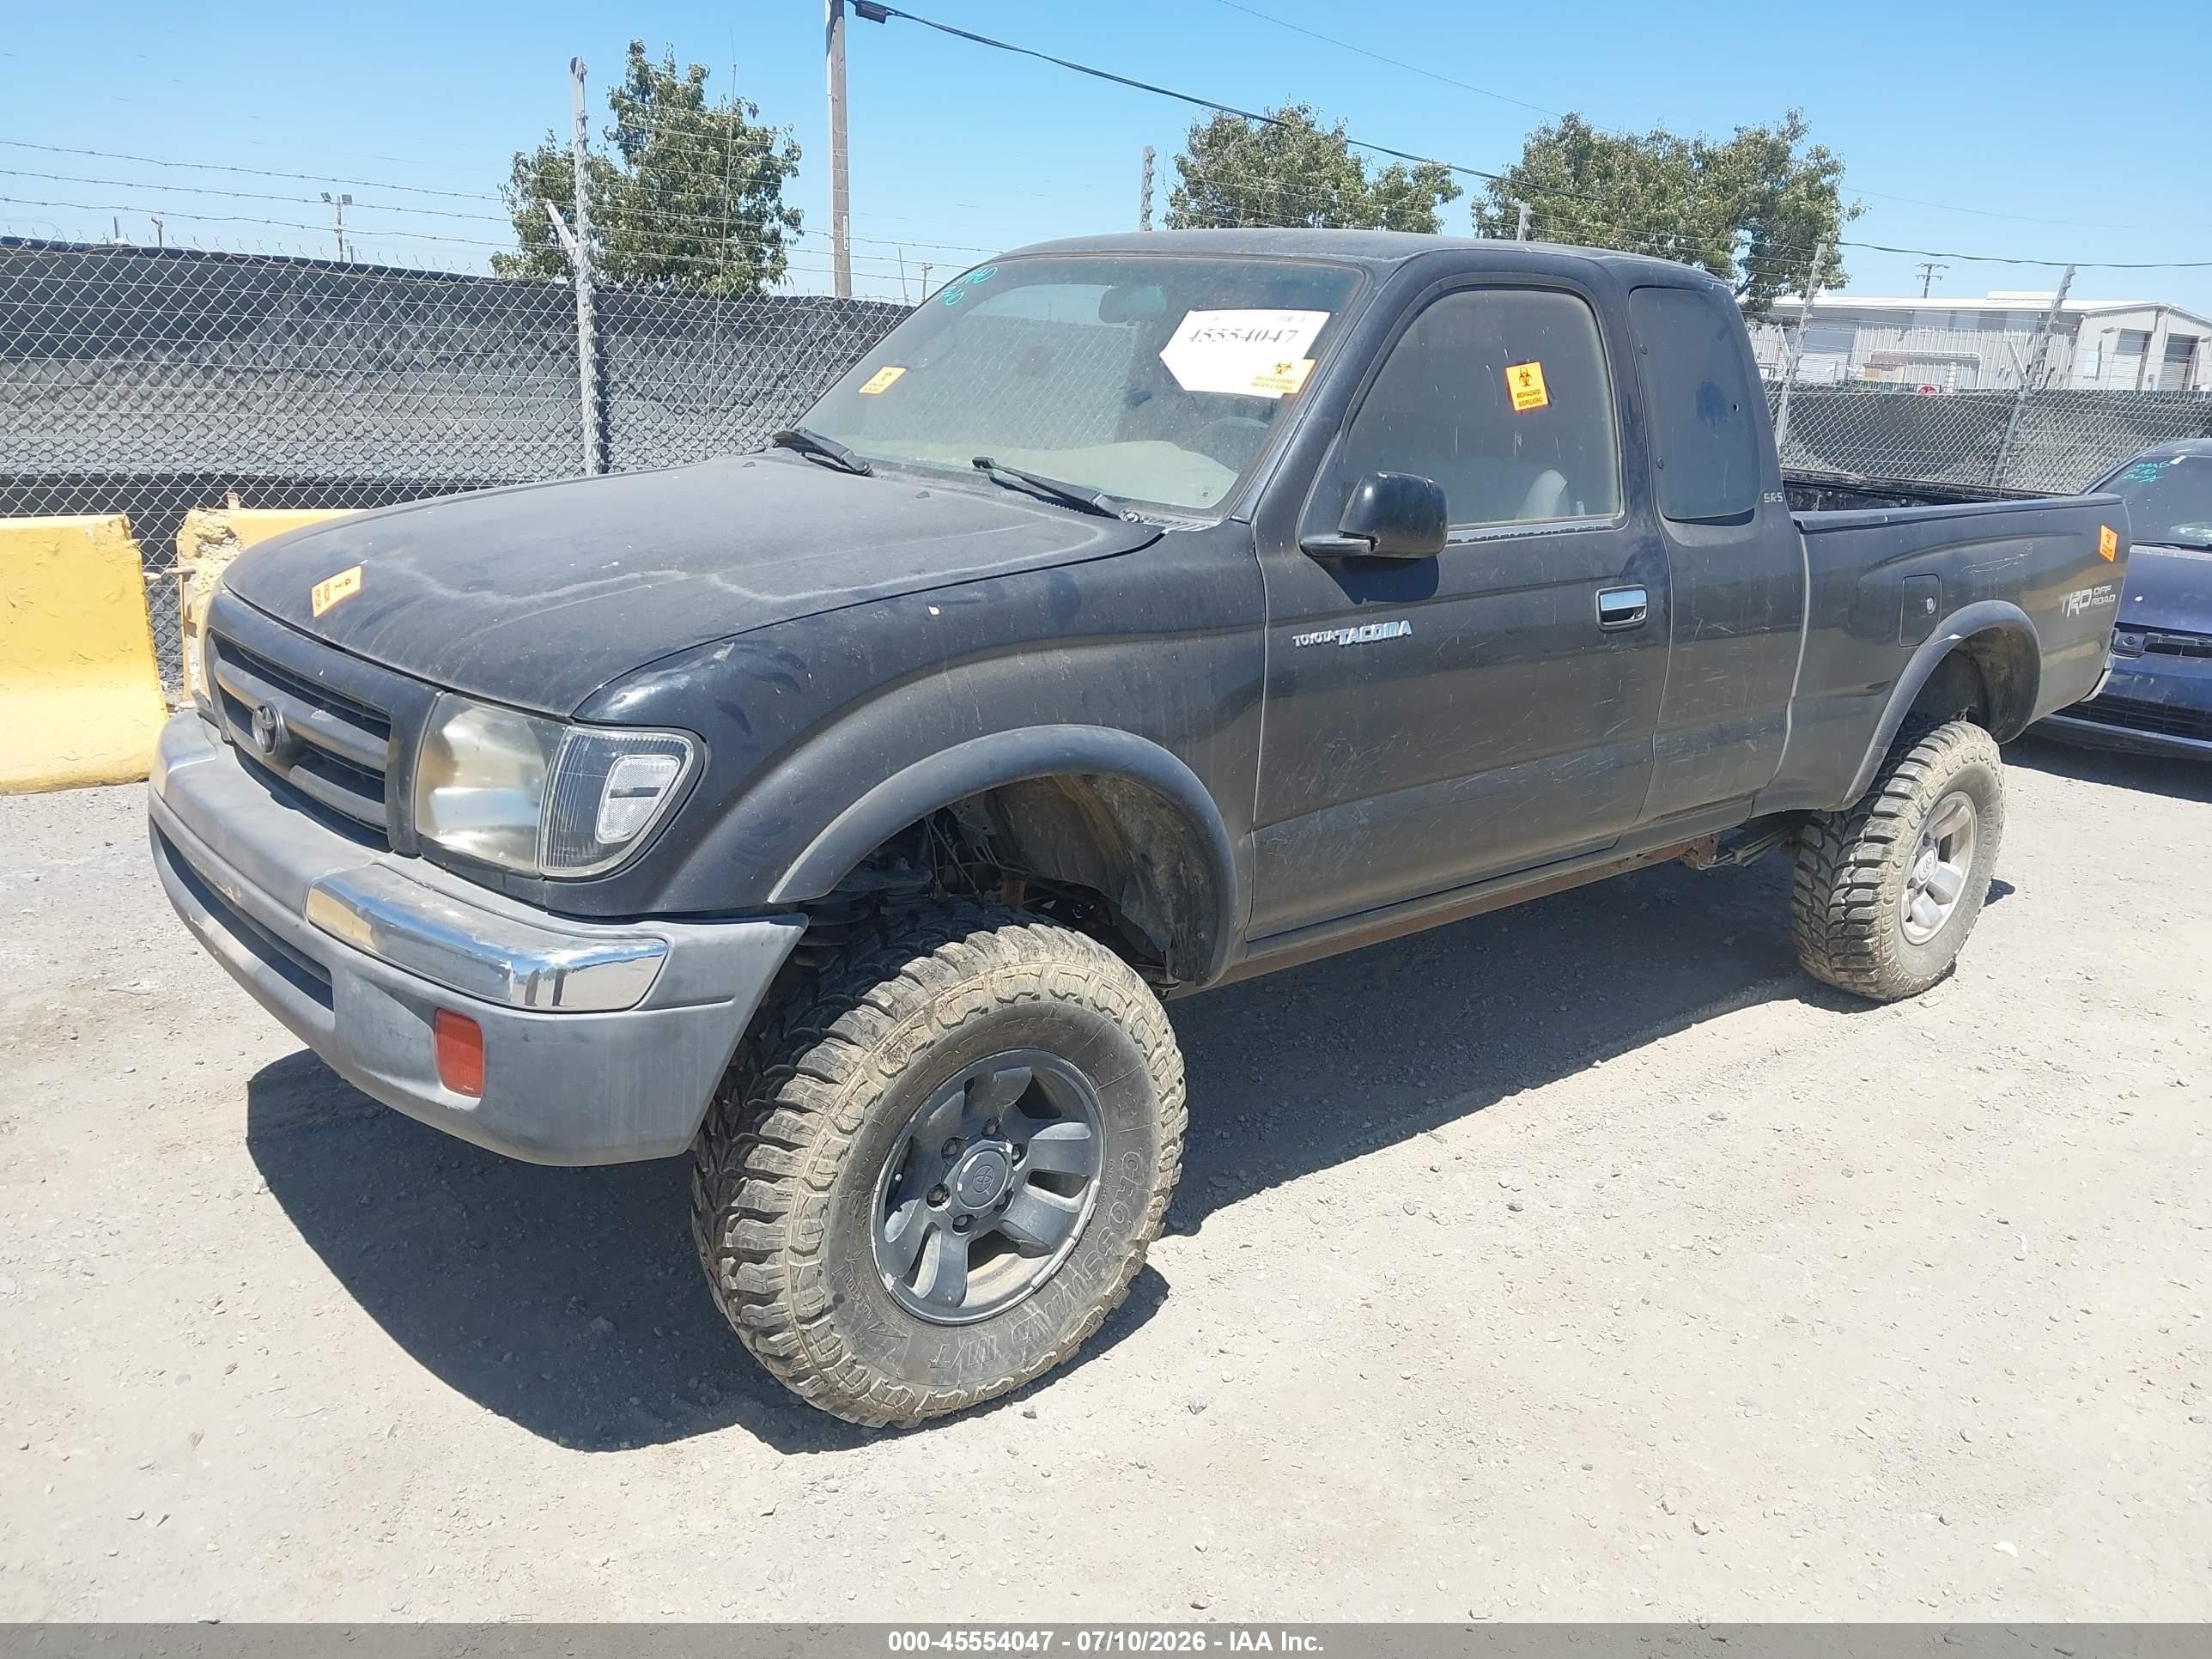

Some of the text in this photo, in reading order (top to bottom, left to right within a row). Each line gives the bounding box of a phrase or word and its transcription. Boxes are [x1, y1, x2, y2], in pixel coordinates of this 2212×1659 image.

[2091, 593, 2116, 606] ROAD
[2093, 585, 2112, 596] OFF
[2059, 588, 2092, 617] TRD
[1291, 619, 1413, 647] TOYOTA TACOMA
